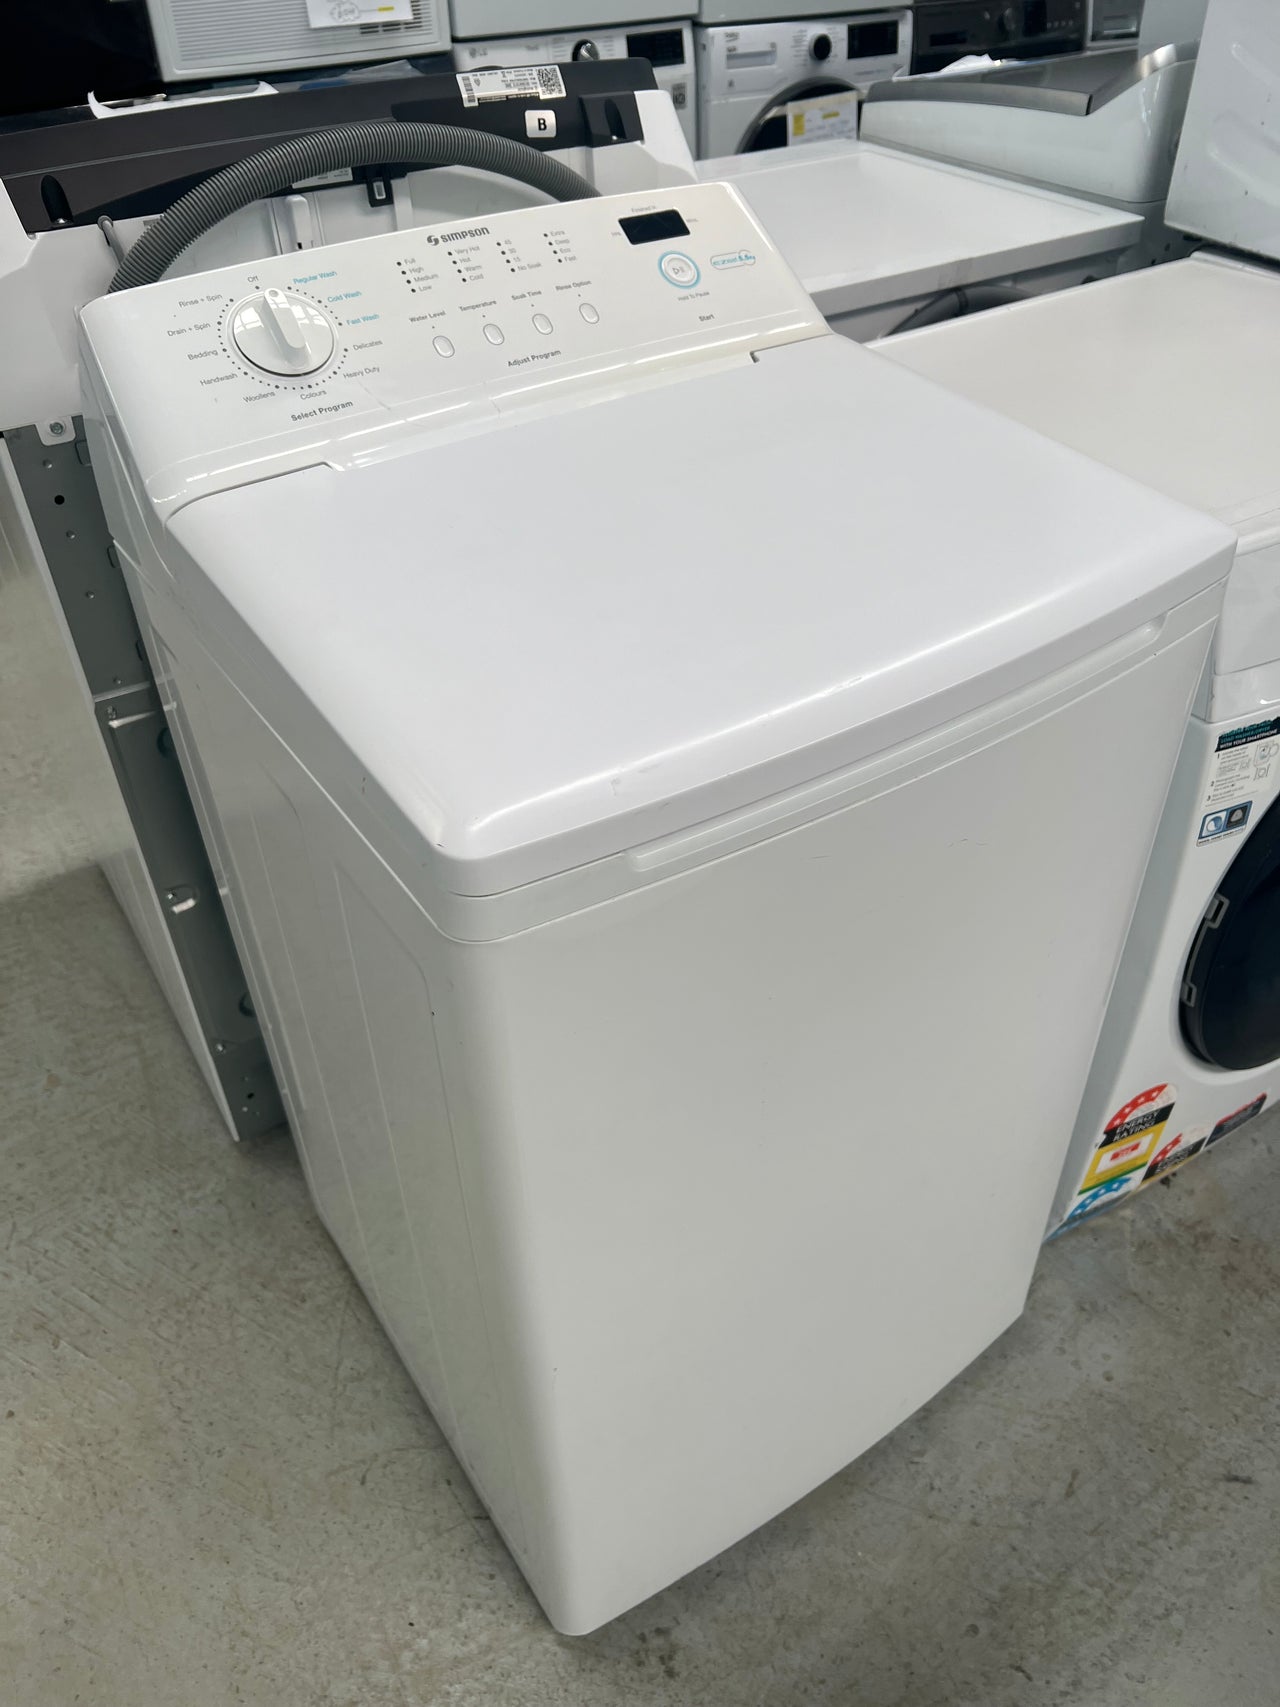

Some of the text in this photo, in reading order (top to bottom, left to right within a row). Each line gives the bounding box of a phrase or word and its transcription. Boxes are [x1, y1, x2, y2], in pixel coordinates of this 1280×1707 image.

[537, 118, 547, 131] B
[440, 227, 490, 243] SIMPSON
[410, 266, 424, 274] High
[465, 264, 482, 272] Warm
[293, 270, 337, 285] Regular Wash
[414, 273, 439, 283] Medium
[419, 284, 432, 292] Low
[556, 280, 592, 292] Rinse Option
[178, 298, 198, 308] Rinse
[206, 293, 223, 304] Spin
[327, 290, 362, 303] Cold Wash
[511, 293, 526, 301] Soak
[460, 300, 497, 312] Temperature
[346, 313, 379, 326] Fast Wash
[409, 310, 446, 323] Water Level
[167, 327, 186, 337] Drain
[194, 322, 211, 334] Spin
[352, 339, 383, 351] Delicates
[187, 349, 218, 361] Bedding
[508, 349, 561, 367] Adjust Program
[200, 372, 238, 387] Handwash
[343, 366, 380, 380] Heavy Duty
[243, 390, 276, 403] Woollens
[300, 389, 327, 400] Colours
[291, 400, 353, 422] Select Program
[1116, 1111, 1159, 1134] ENERGY
[1113, 1121, 1156, 1142] RATING
